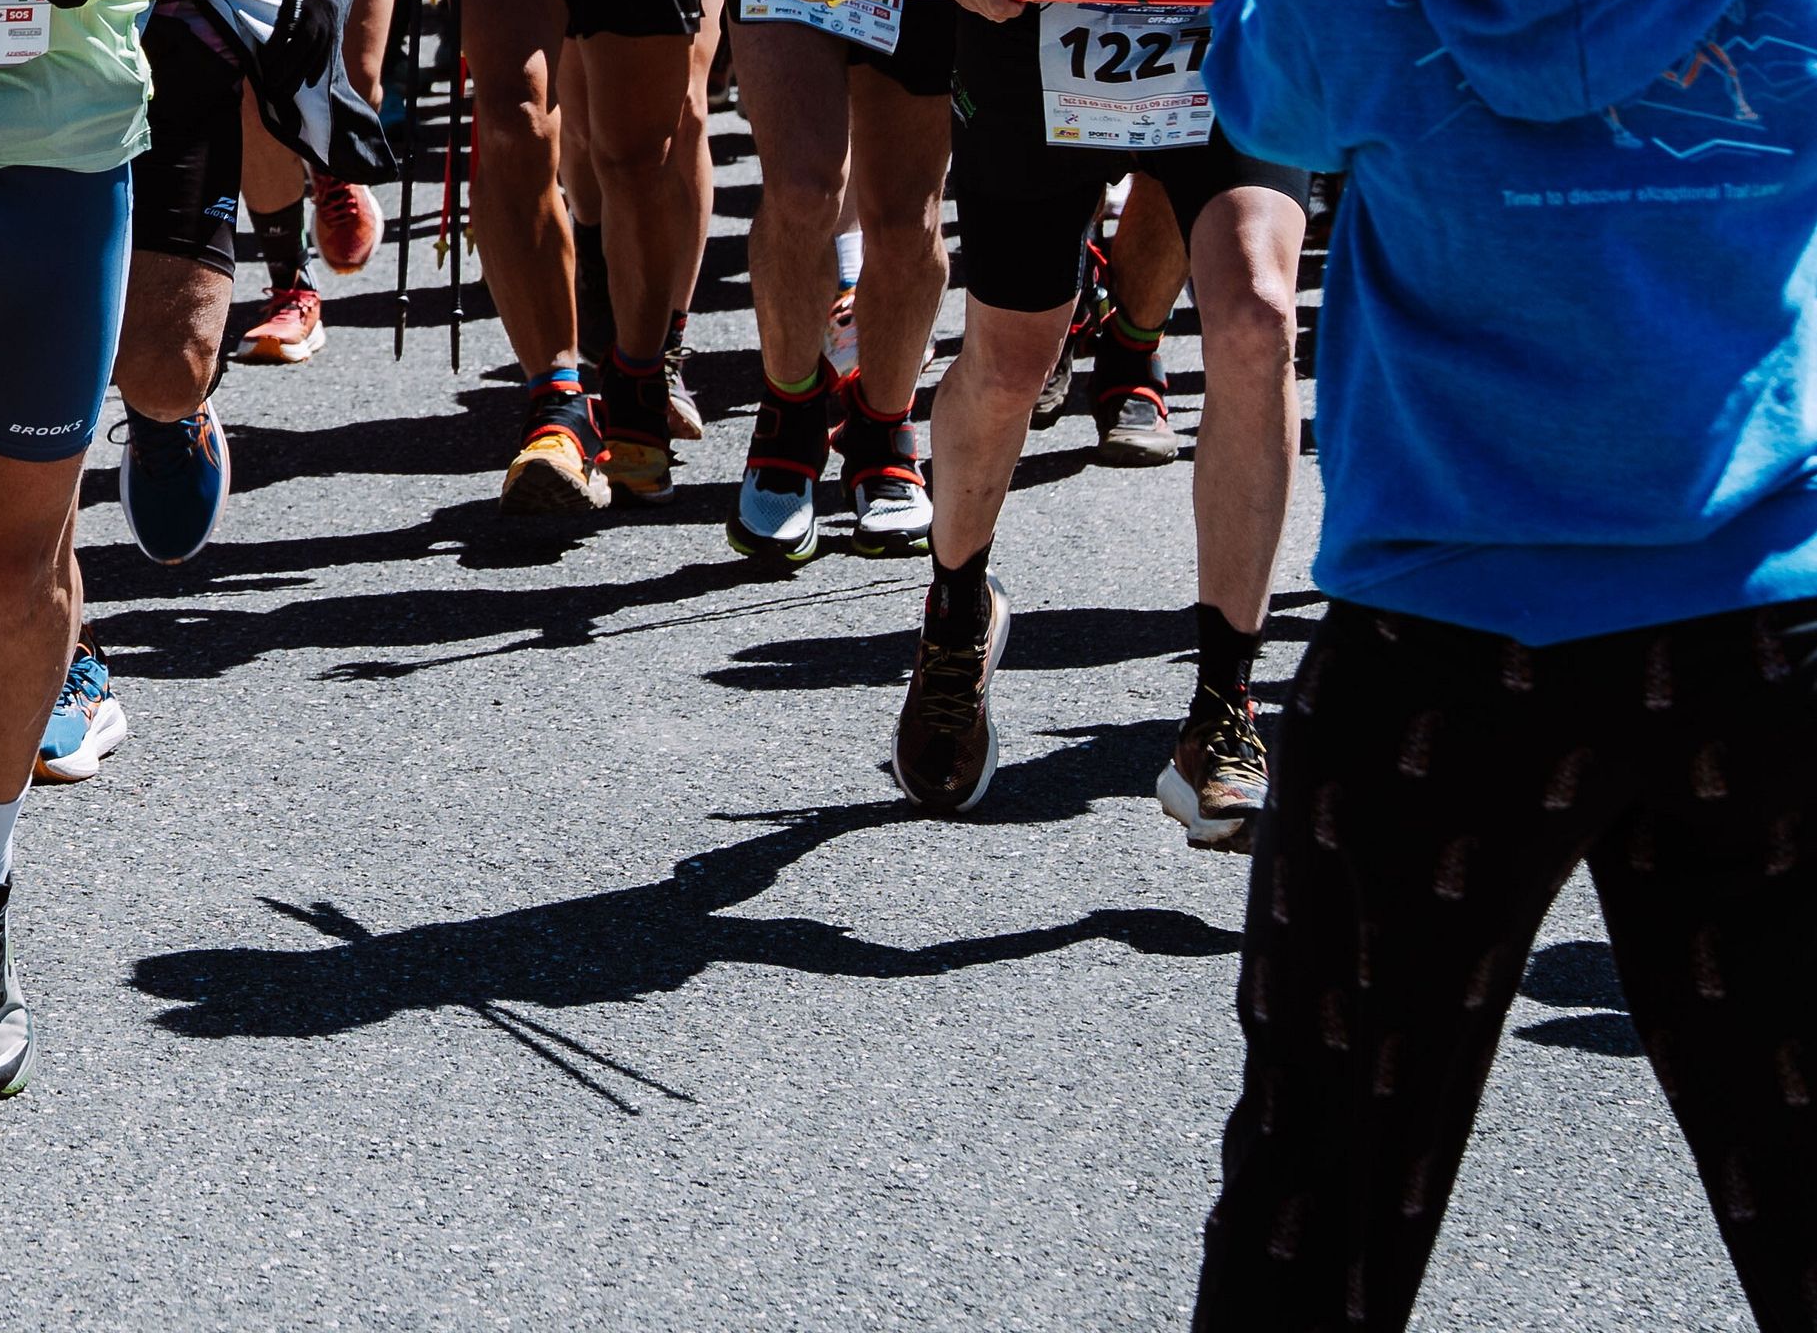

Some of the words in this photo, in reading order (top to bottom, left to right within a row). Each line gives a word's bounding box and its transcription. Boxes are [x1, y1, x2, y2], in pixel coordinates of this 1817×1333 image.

[9, 10, 29, 19] SOS
[1059, 27, 1212, 83] 1227
[1503, 190, 1543, 206] Time
[1546, 190, 1565, 205] to
[1568, 188, 1632, 204] discover
[9, 419, 83, 436] BROOKS
